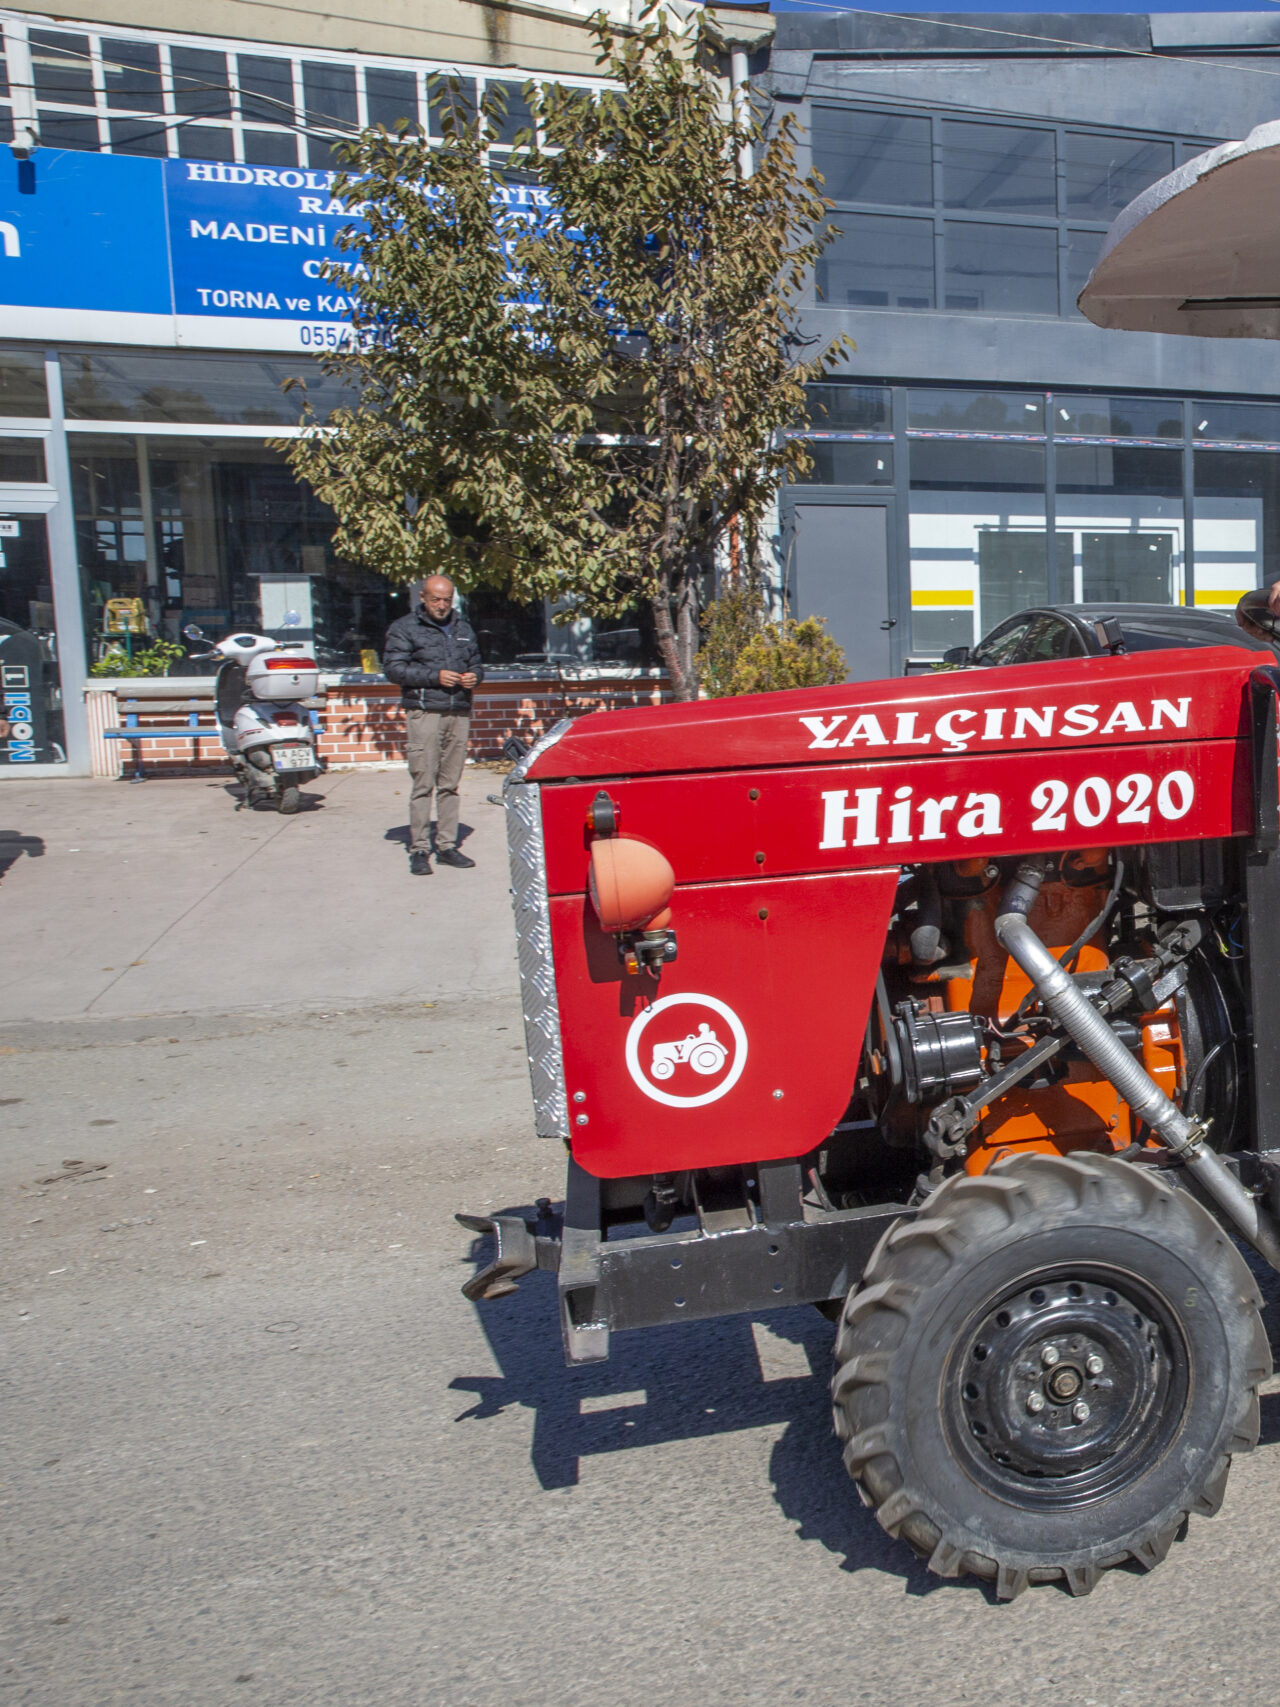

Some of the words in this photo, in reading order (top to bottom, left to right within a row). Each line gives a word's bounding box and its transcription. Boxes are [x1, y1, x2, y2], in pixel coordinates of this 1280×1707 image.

[189, 219, 327, 247] MADENİ
[196, 288, 281, 311] TORNA
[285, 297, 312, 312] ve
[4, 692, 36, 762] Mobil
[798, 697, 1193, 752] YALÇINSAN
[818, 786, 1003, 850] Hira
[1030, 770, 1195, 831] 2020
